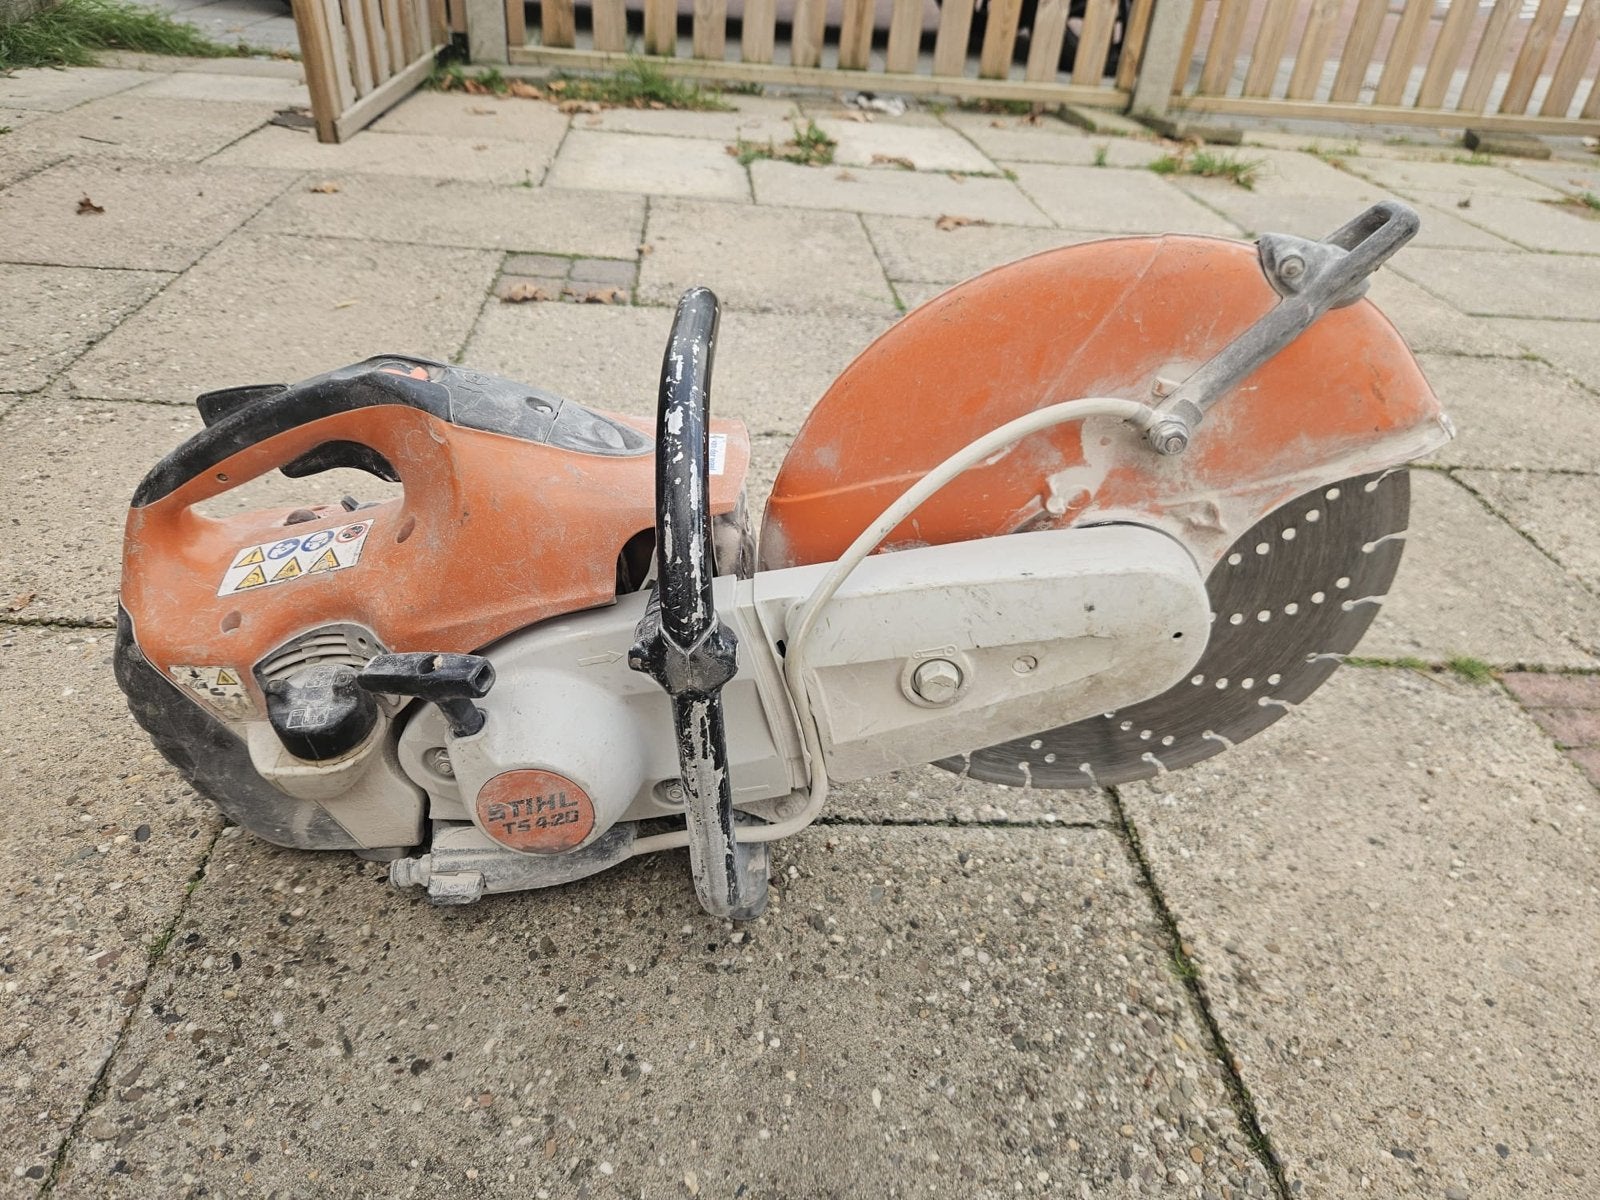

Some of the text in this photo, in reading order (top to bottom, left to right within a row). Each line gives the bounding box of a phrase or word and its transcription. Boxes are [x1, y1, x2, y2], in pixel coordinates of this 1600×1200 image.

[488, 791, 578, 822] STIHL
[502, 810, 579, 834] TS 420
